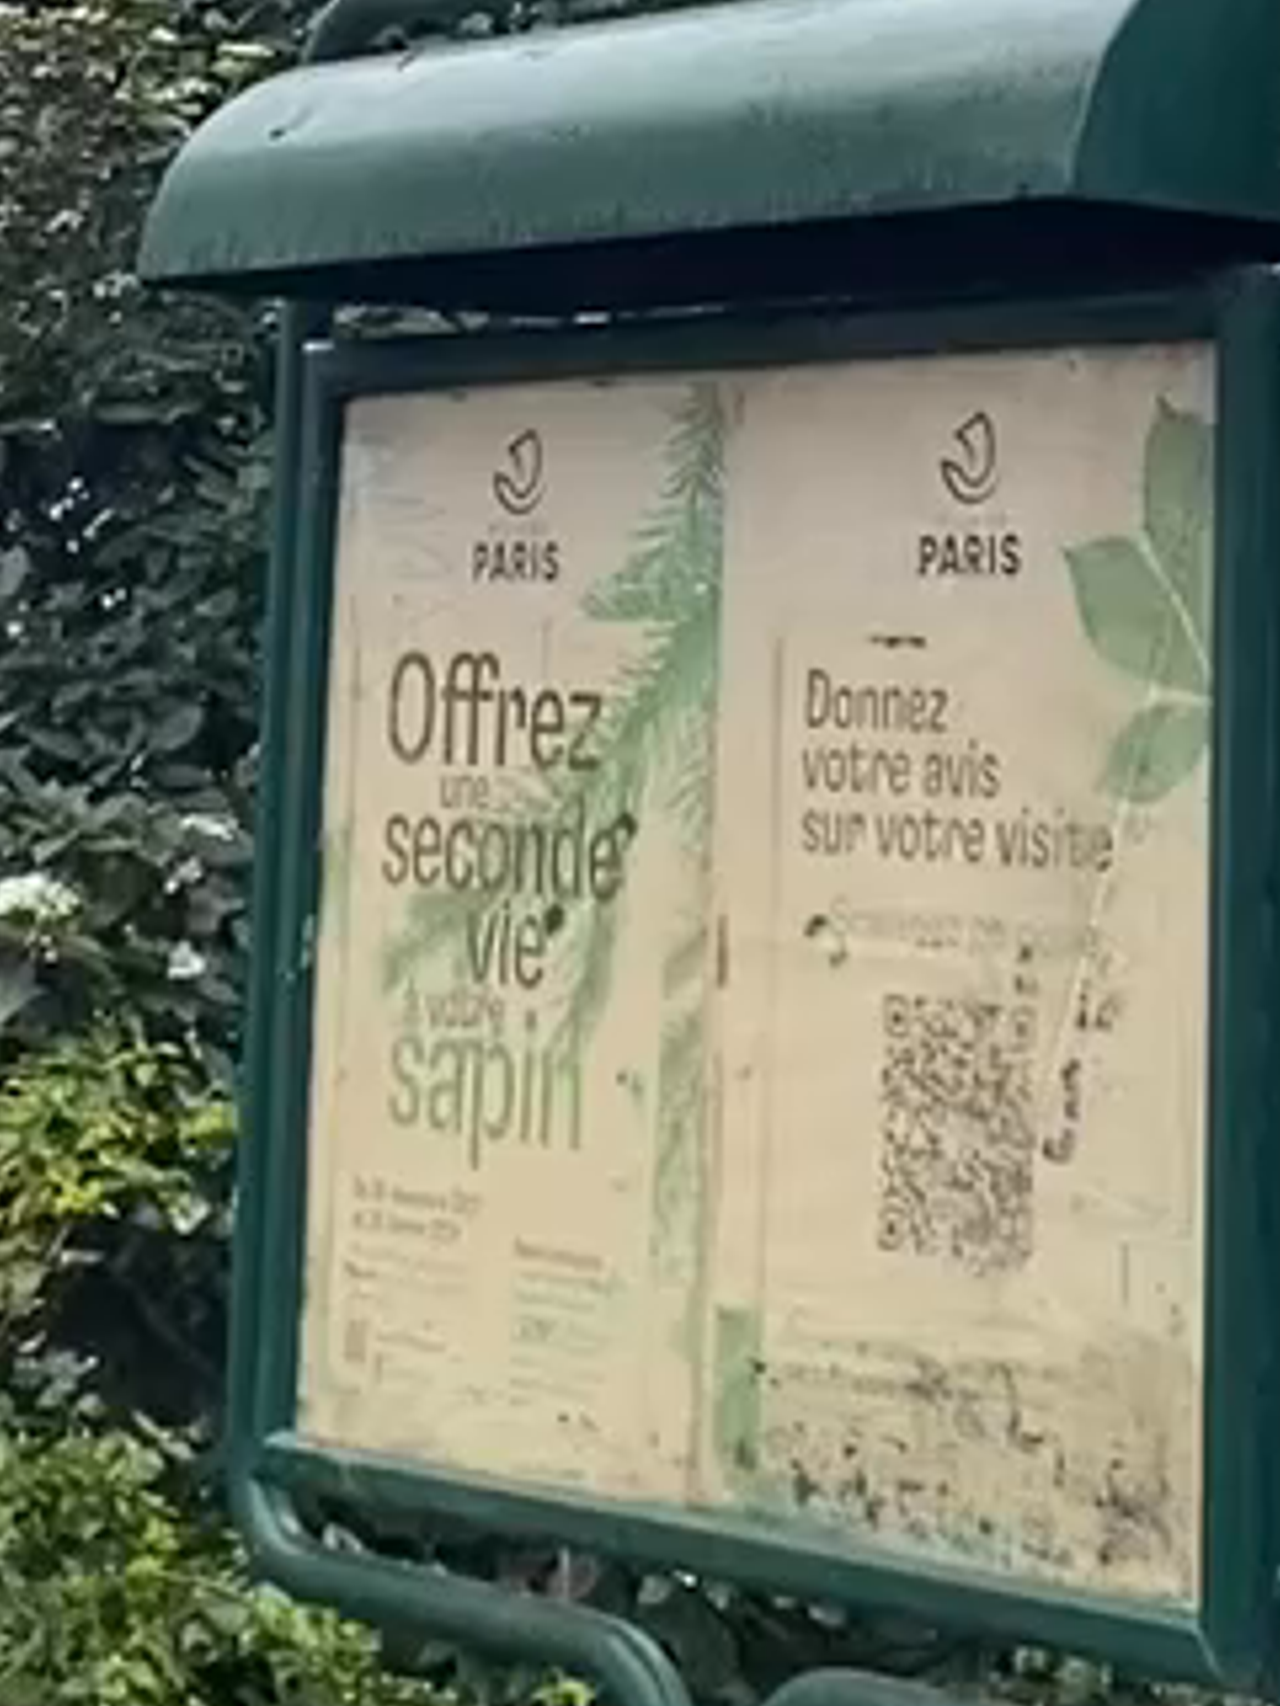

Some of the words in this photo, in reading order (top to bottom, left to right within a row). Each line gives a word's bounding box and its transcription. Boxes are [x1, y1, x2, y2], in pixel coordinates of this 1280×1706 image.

[472, 540, 560, 583] PARIS
[917, 533, 1022, 577] PARIS
[387, 650, 605, 772] Offrez
[806, 668, 949, 734] Donnez
[440, 773, 491, 810] une
[802, 742, 912, 796] votre
[922, 738, 1003, 800] avis
[381, 794, 626, 904] seconde
[802, 808, 866, 855] sur
[874, 807, 987, 866] votre
[995, 805, 1114, 873] visite
[466, 898, 547, 990] vie
[387, 1010, 582, 1171] sapin
